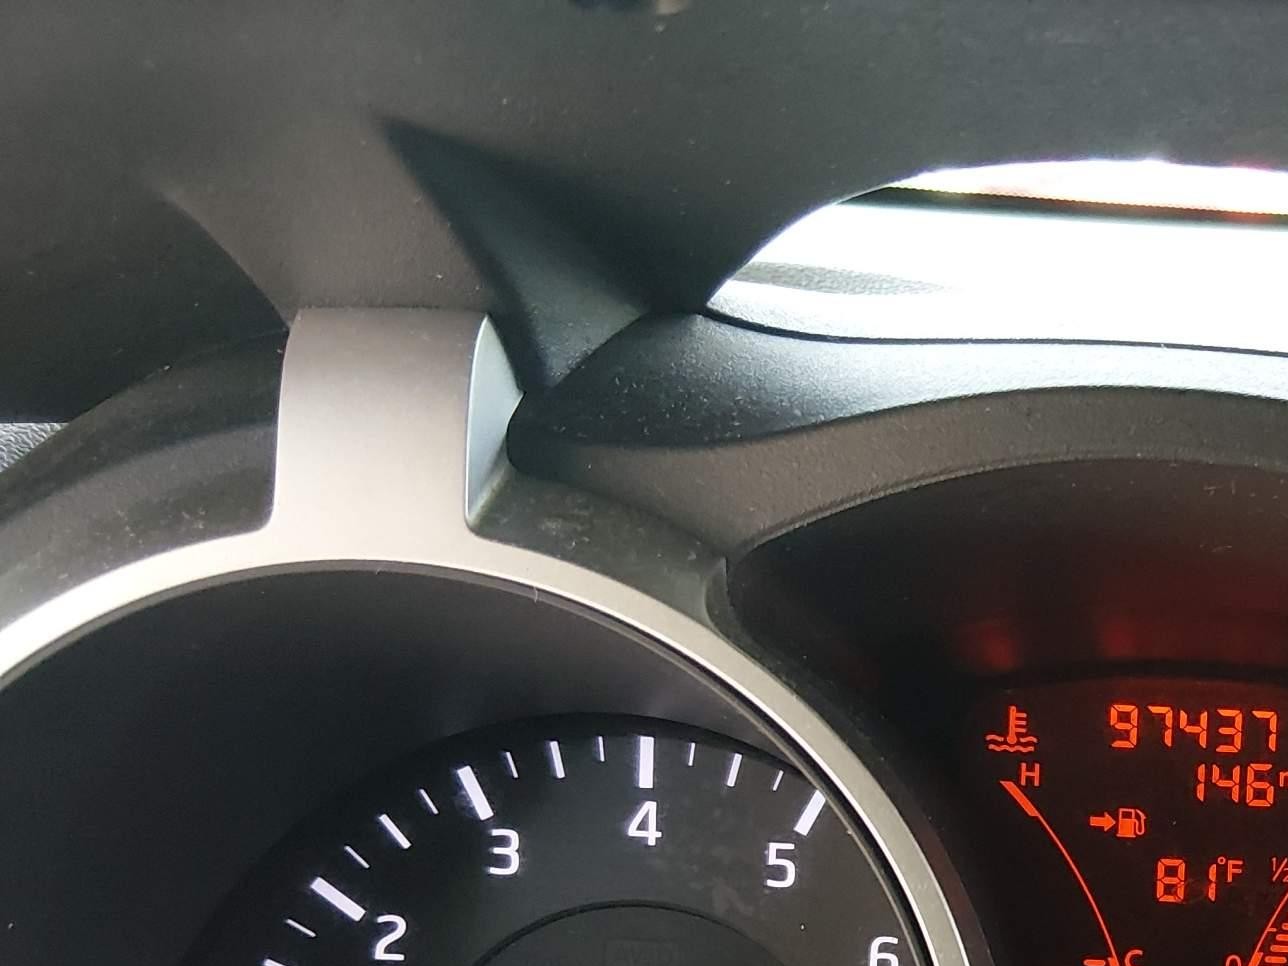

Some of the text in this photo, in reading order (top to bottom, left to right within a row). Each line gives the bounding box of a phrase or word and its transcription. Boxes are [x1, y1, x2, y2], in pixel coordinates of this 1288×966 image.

[1109, 703, 1278, 753] 97437
[1019, 762, 1040, 787] H
[1196, 763, 1275, 807] 146
[626, 800, 662, 846] 4
[487, 828, 520, 876] 3
[766, 842, 796, 888] 5
[373, 914, 407, 961] 2
